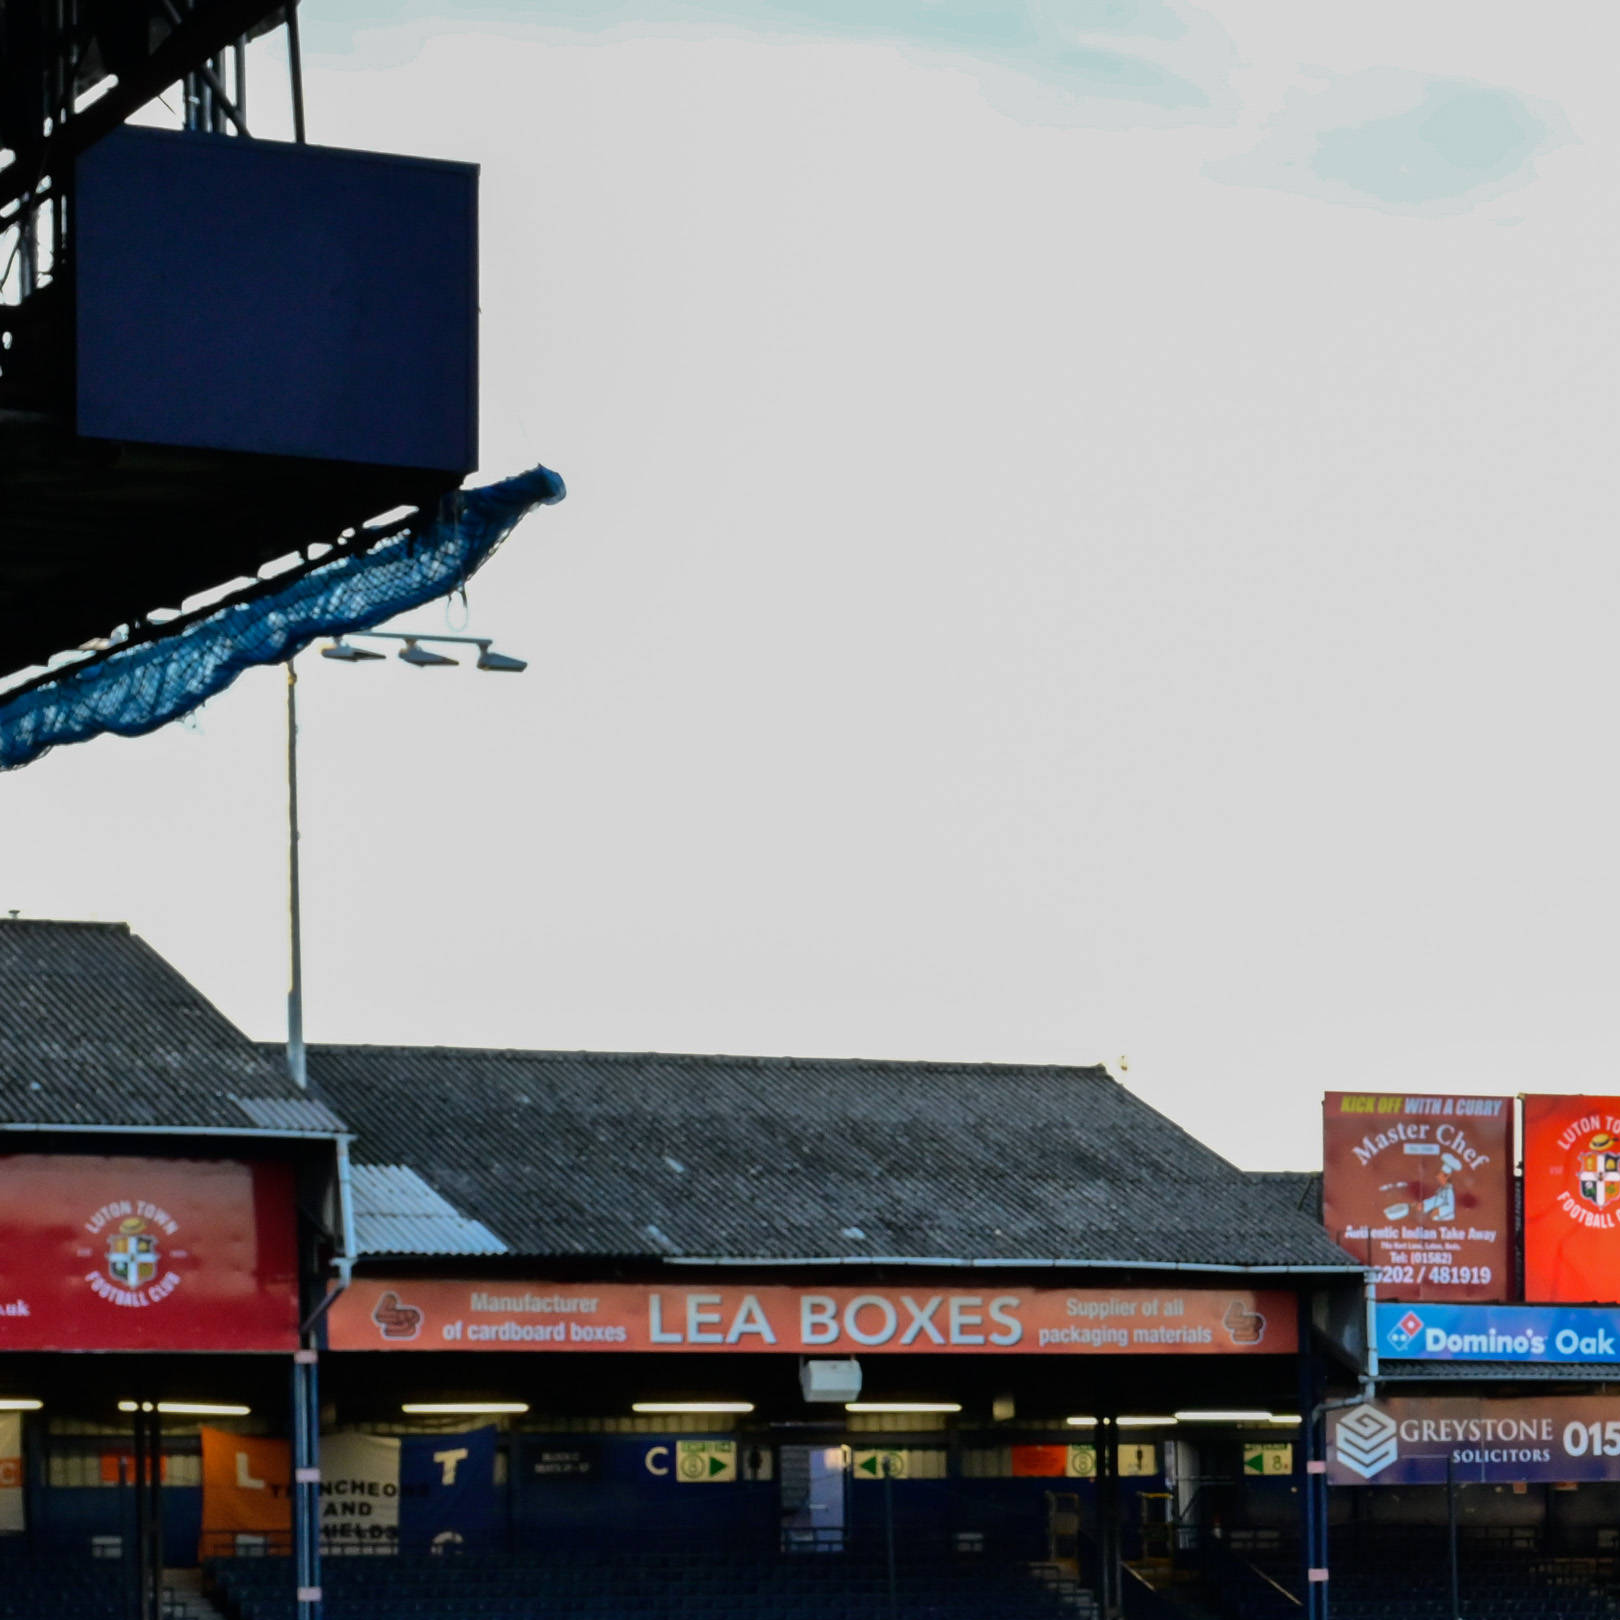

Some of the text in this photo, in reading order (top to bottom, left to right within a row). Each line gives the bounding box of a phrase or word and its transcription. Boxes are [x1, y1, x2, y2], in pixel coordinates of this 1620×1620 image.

[1341, 1096, 1503, 1117] KICK OFF WITH A CURRY
[1557, 1115, 1600, 1150] LUTON
[1352, 1122, 1490, 1171] Master Chef
[85, 1200, 178, 1235] LUTON TOWN
[1557, 1191, 1615, 1228] FOOTBALL
[1402, 1226, 1436, 1239] Indian
[1439, 1228, 1465, 1240] Take
[1468, 1228, 1496, 1242] Away
[1429, 1266, 1491, 1284] 481919
[85, 1271, 181, 1307] FOOTBALL CLUB
[470, 1292, 599, 1313] Manufacturer
[1066, 1298, 1185, 1319] Supplier of all
[442, 1320, 627, 1342] of cardboard boxes
[649, 1294, 1023, 1346] LEA BOXES
[1039, 1326, 1213, 1347] packaging materials
[1425, 1328, 1546, 1355] Domino's
[1555, 1329, 1616, 1355] Oak
[1400, 1418, 1553, 1442] GREYSTONE
[432, 1447, 469, 1486] T
[644, 1446, 670, 1476] C
[1453, 1448, 1551, 1464] SOLICITORS
[235, 1452, 266, 1490] L
[323, 1501, 372, 1517] AND
